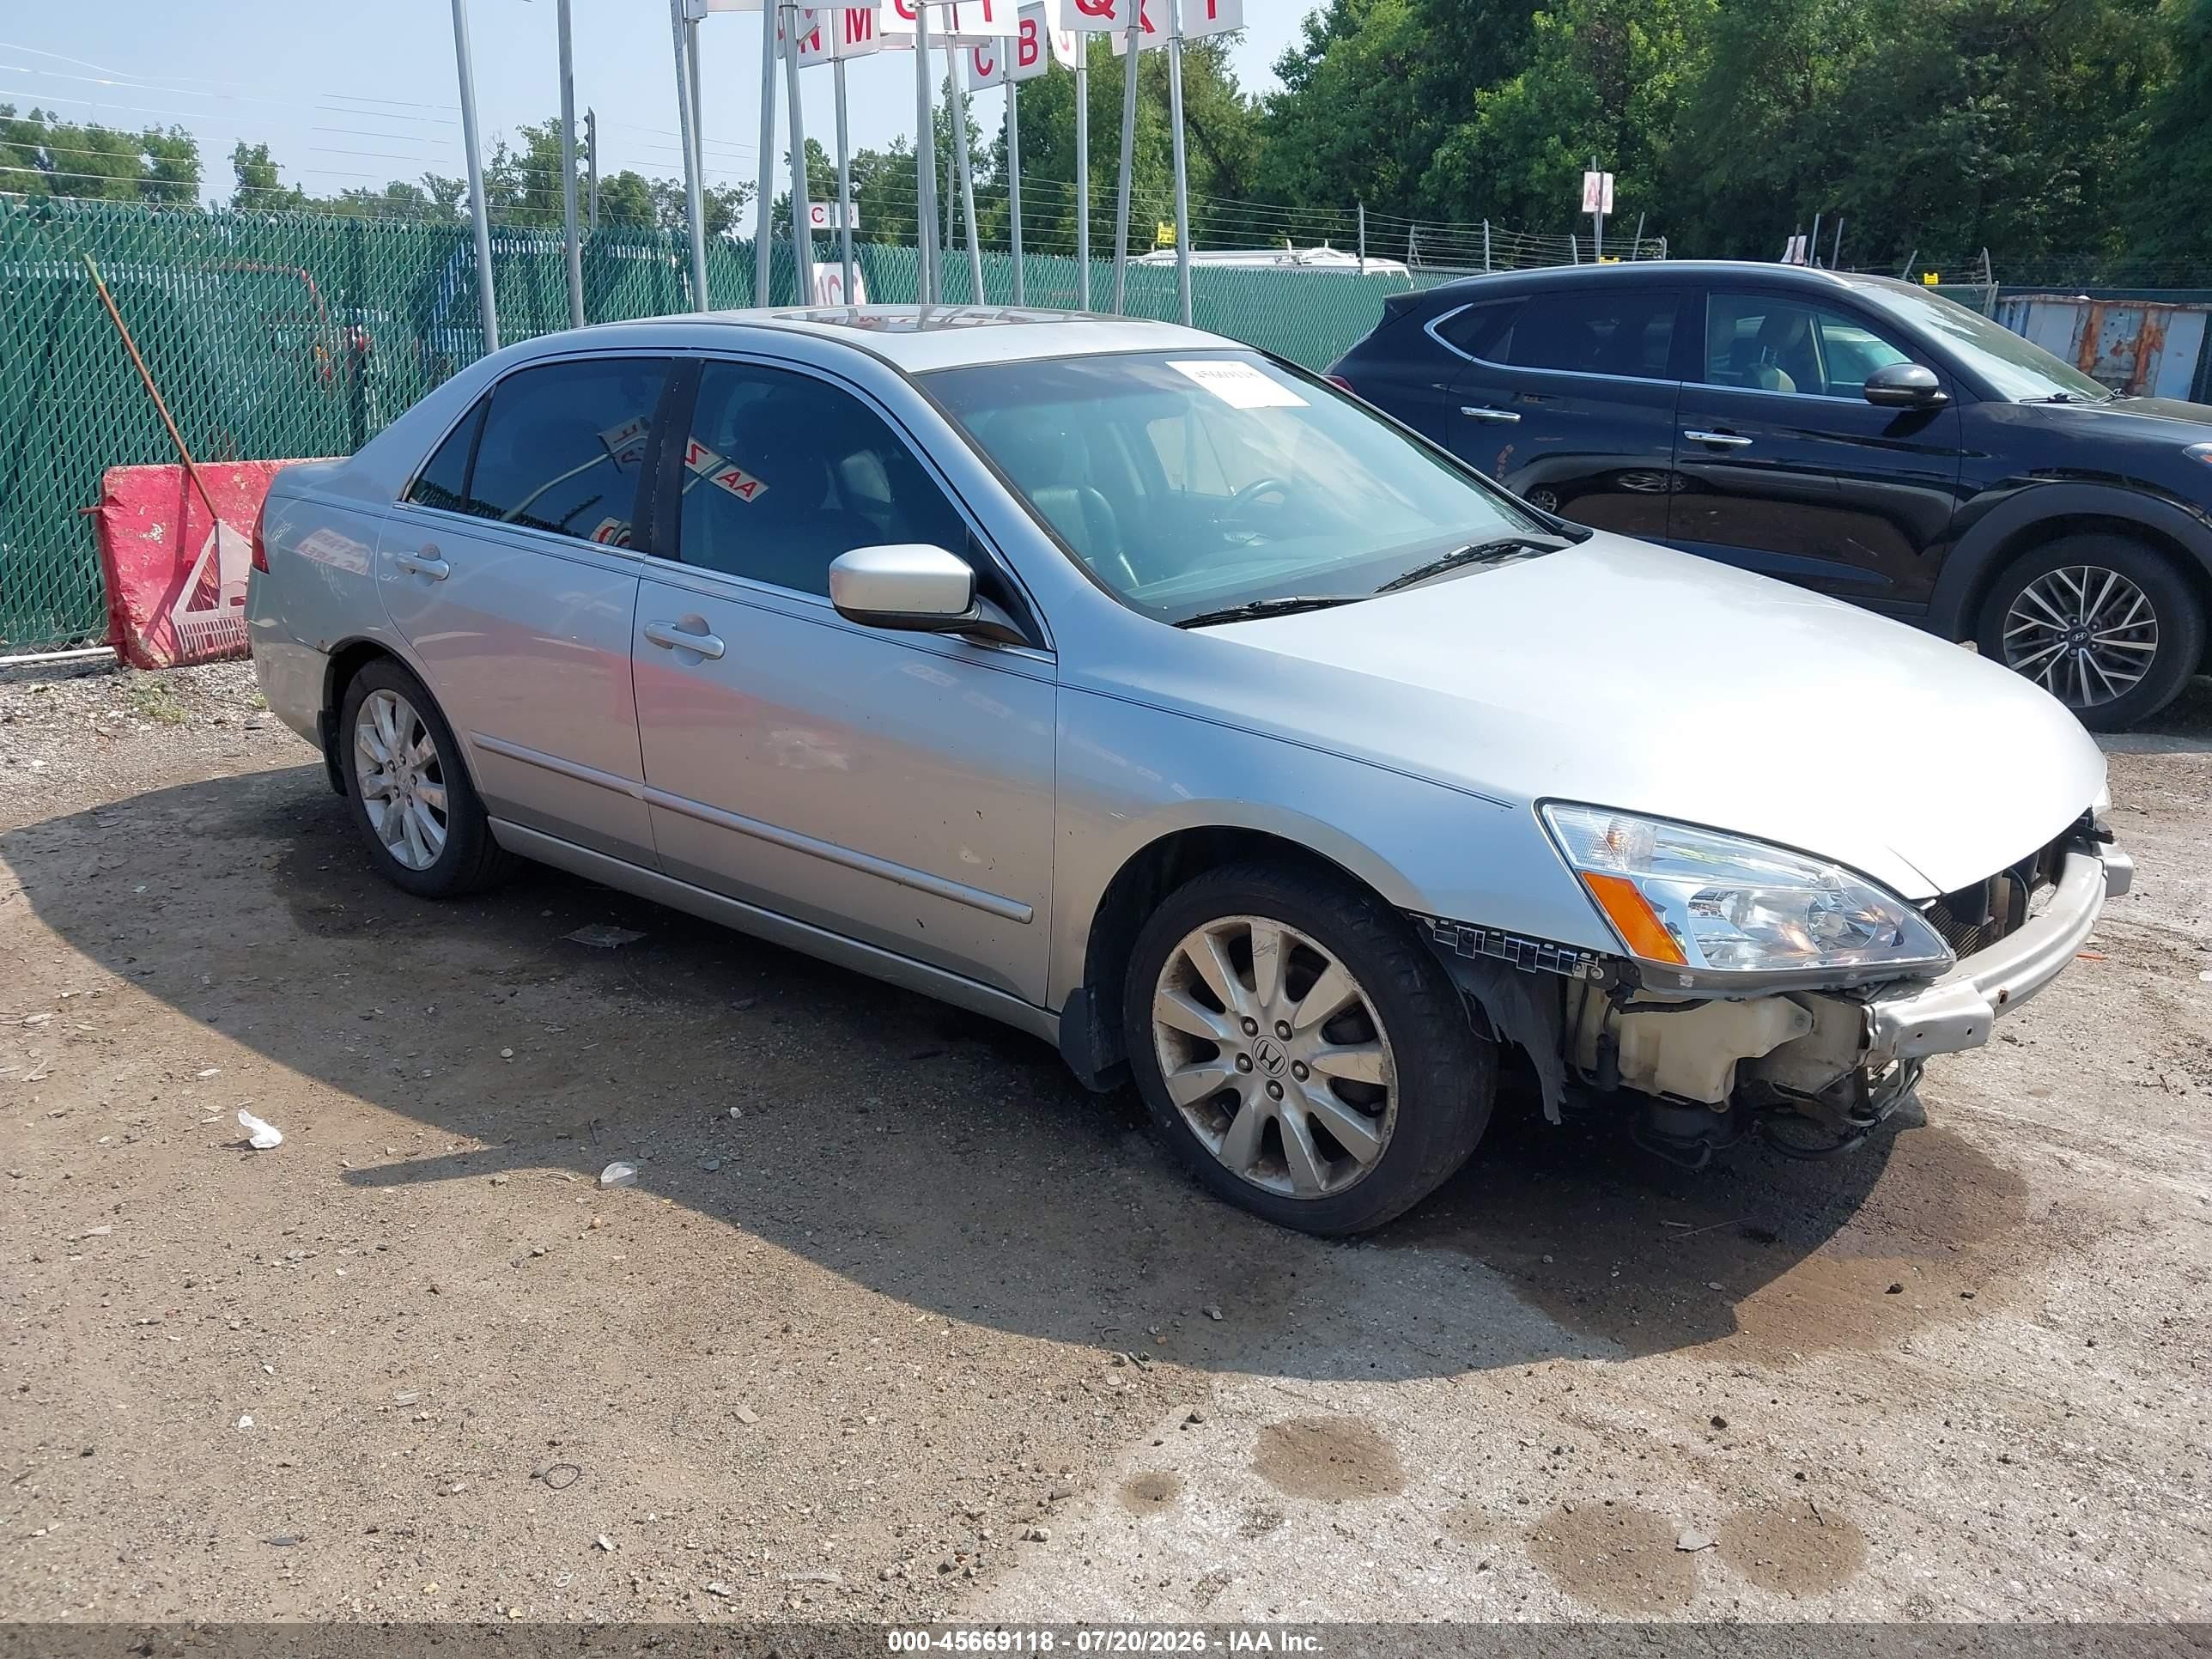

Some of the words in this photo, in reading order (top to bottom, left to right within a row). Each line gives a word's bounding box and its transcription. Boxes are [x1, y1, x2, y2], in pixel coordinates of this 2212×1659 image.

[845, 9, 872, 44] M
[1019, 19, 1038, 67] B
[811, 207, 824, 223] C
